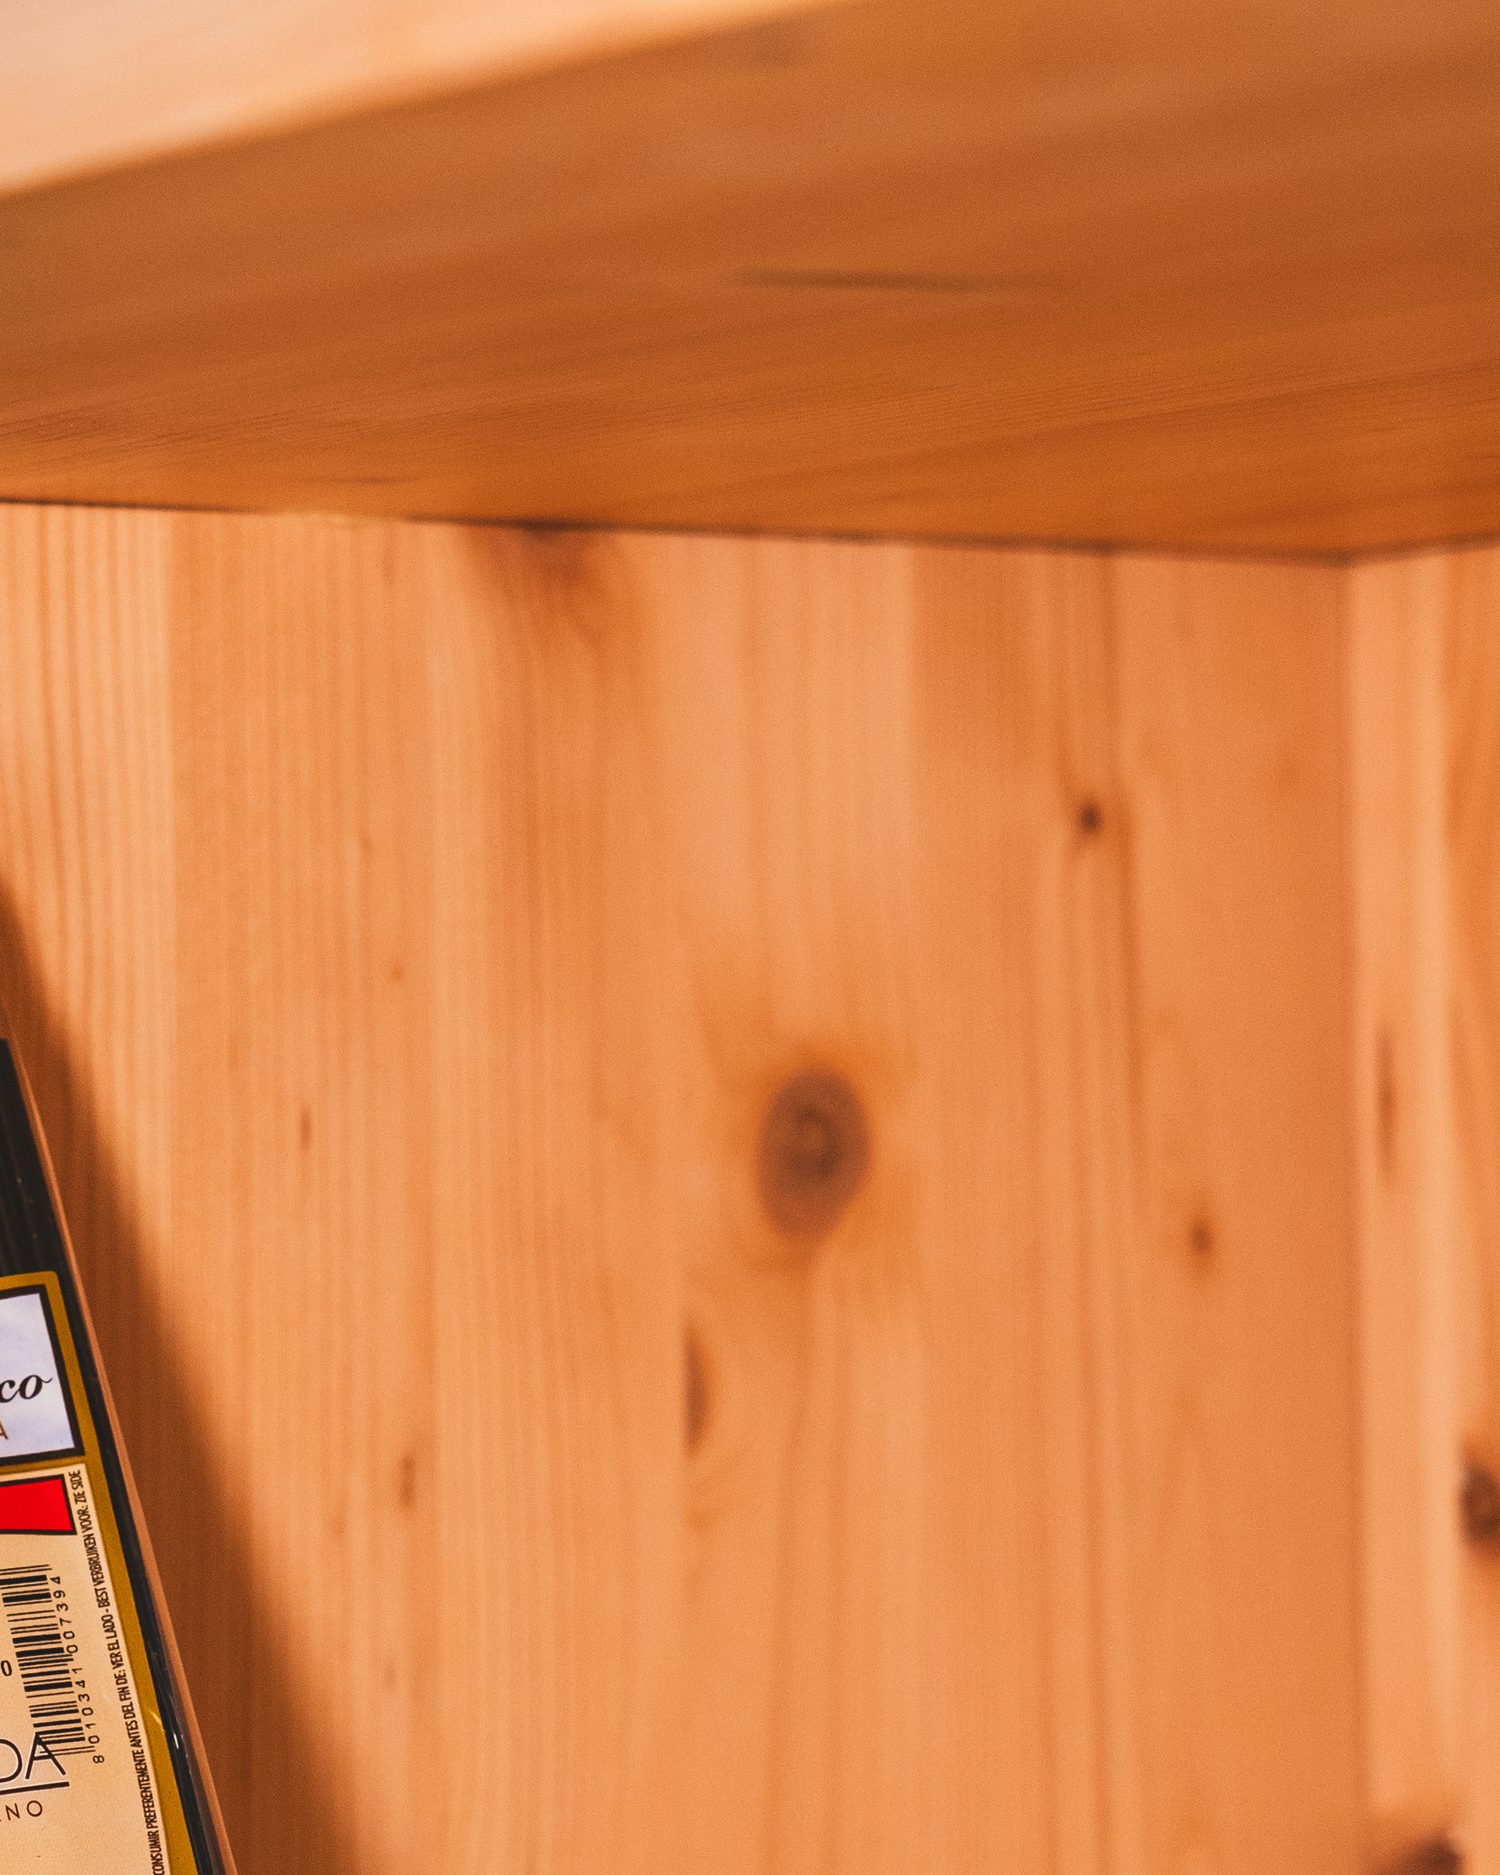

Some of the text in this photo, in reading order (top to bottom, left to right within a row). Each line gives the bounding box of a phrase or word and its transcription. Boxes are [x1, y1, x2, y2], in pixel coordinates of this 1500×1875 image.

[68, 1469, 84, 1490] SIDE
[73, 1490, 87, 1504] ZIE
[77, 1504, 93, 1533] VOOR:
[82, 1532, 105, 1587] VERBRUIKEN
[94, 1587, 111, 1609] BEST
[100, 1613, 120, 1640] LADO
[107, 1639, 120, 1651] EL
[109, 1651, 124, 1670] VER
[114, 1669, 128, 1686] DE:
[117, 1685, 132, 1702] FIN
[121, 1701, 136, 1720] DEL
[125, 1719, 144, 1749] ANTES
[131, 1749, 159, 1830] PREFERENTEMENTE
